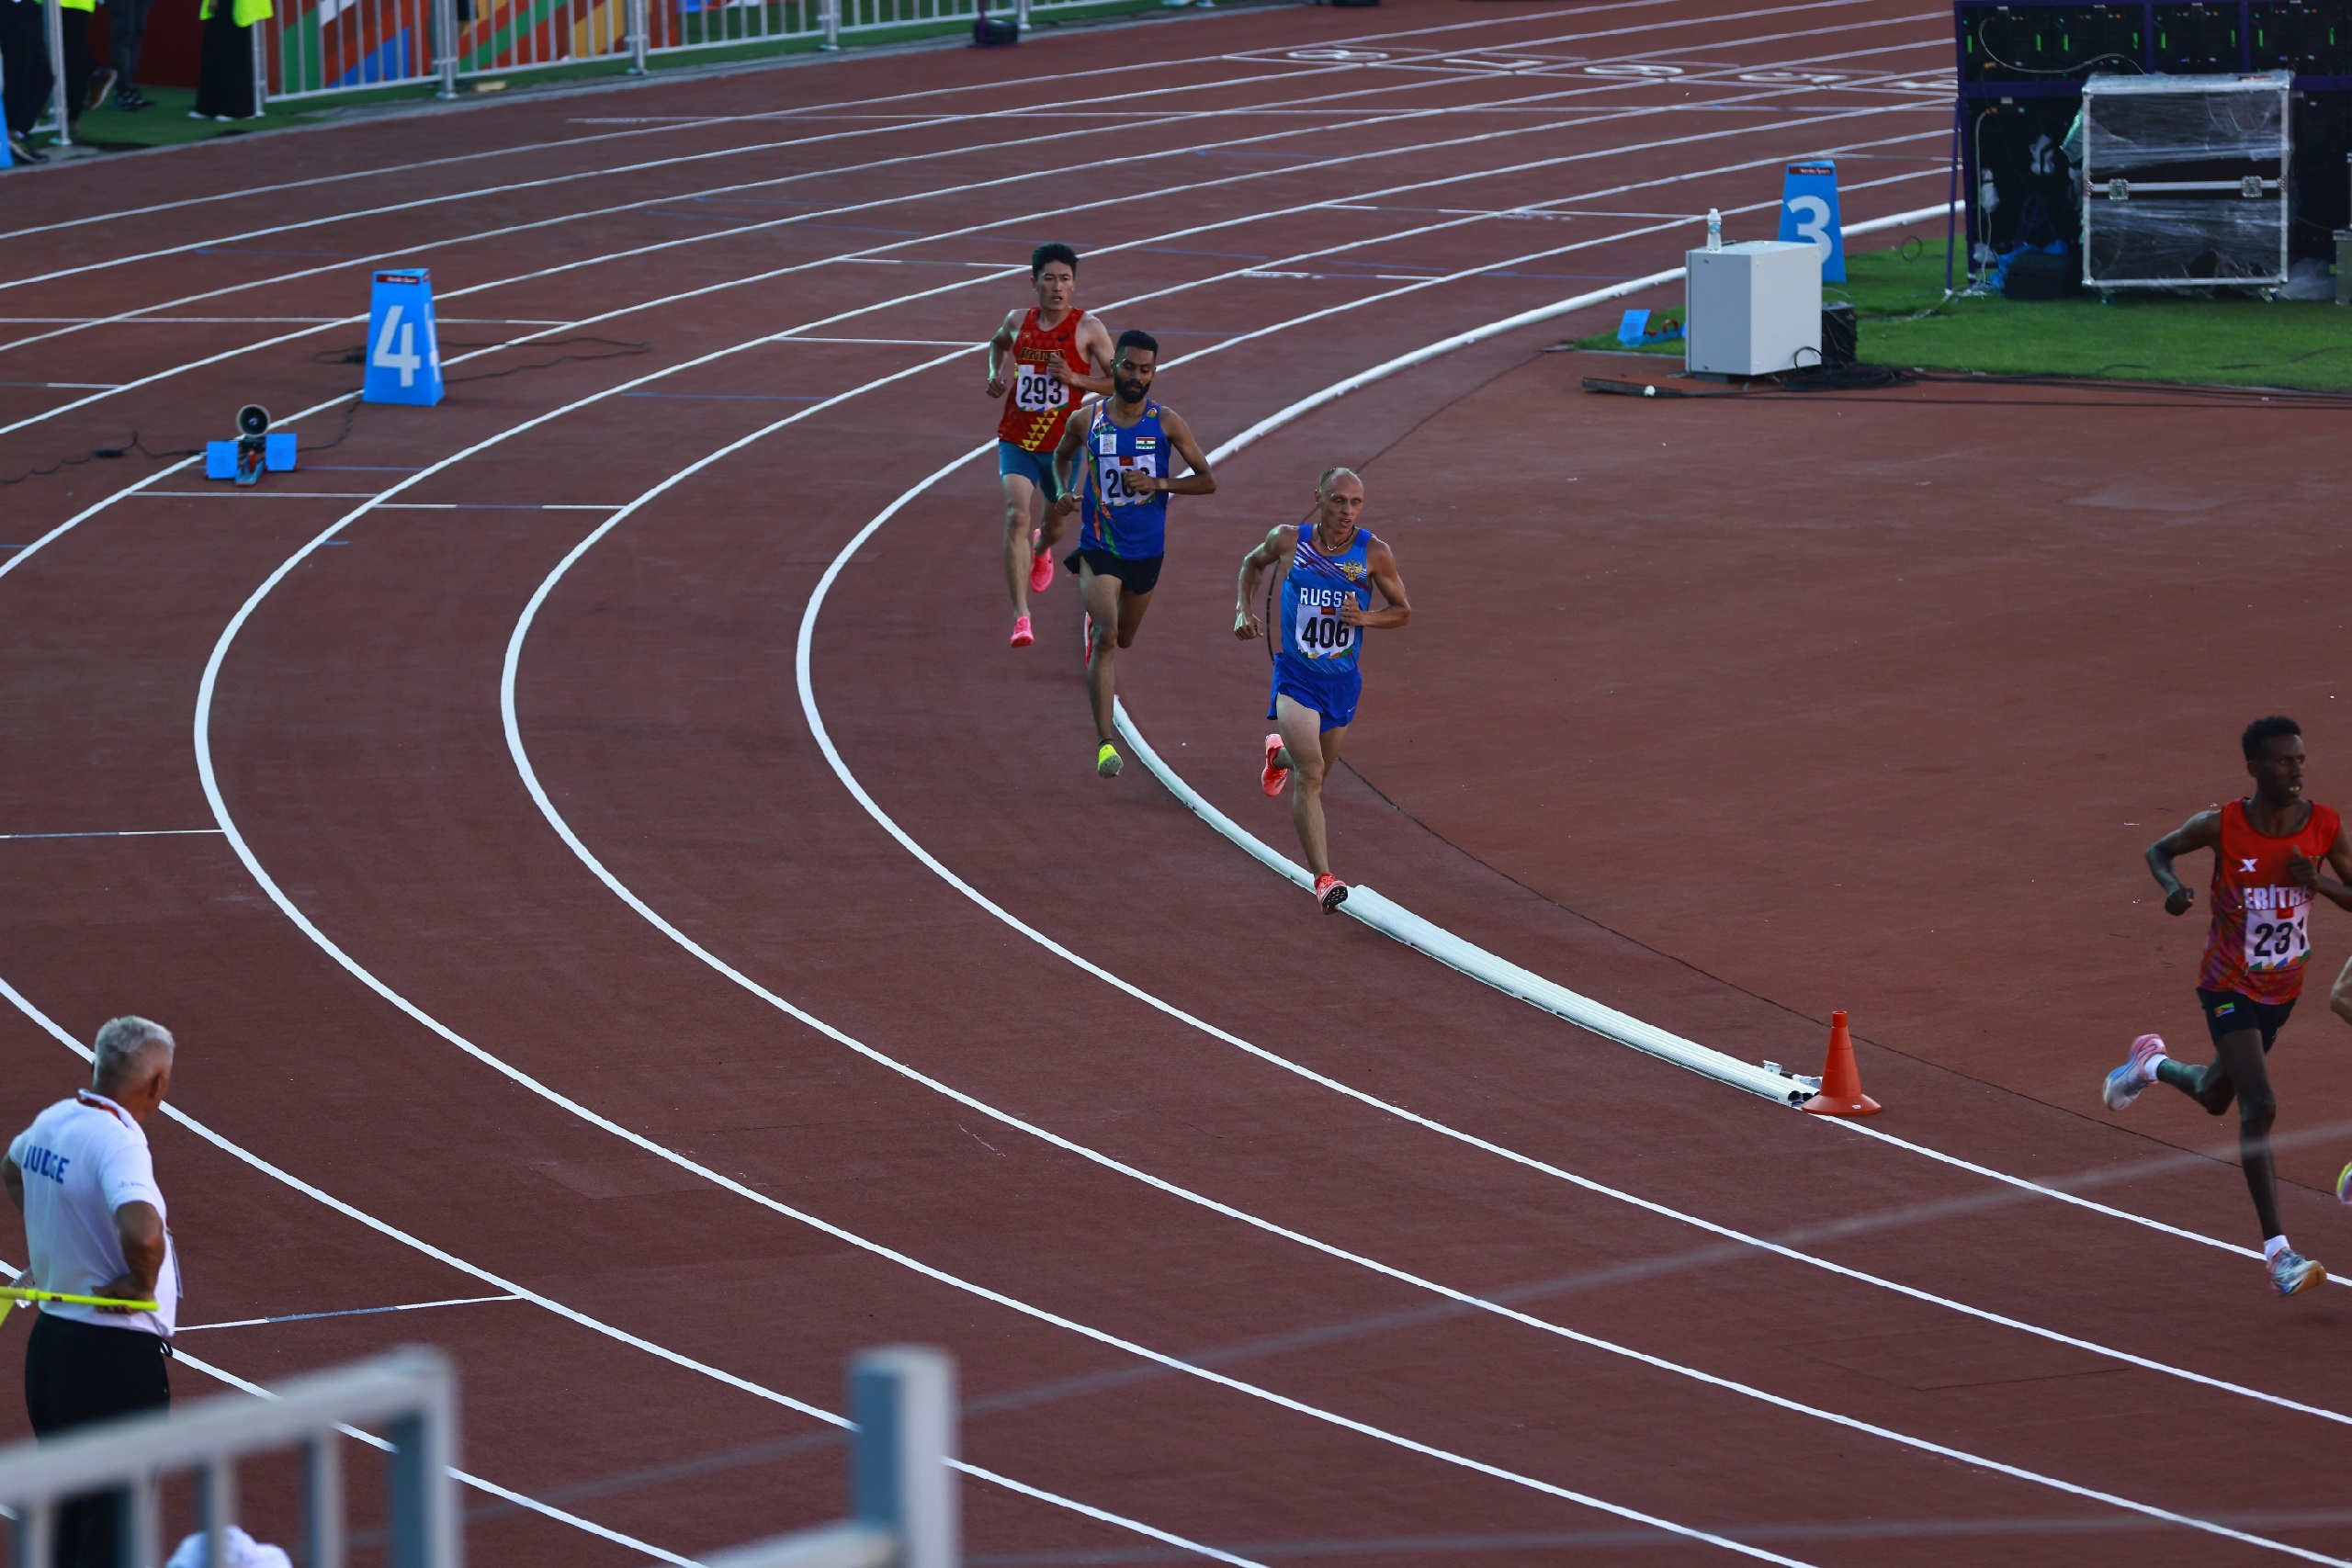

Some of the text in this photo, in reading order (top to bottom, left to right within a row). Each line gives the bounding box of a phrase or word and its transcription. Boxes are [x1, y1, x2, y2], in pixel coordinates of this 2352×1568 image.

[1787, 195, 1833, 265] 3
[373, 305, 421, 387] 4
[1021, 376, 1062, 404] 293
[1300, 587, 1356, 607] RUSS
[1302, 616, 1350, 649] 406
[2255, 916, 2305, 957] 231
[23, 1145, 70, 1184] JUDGE
